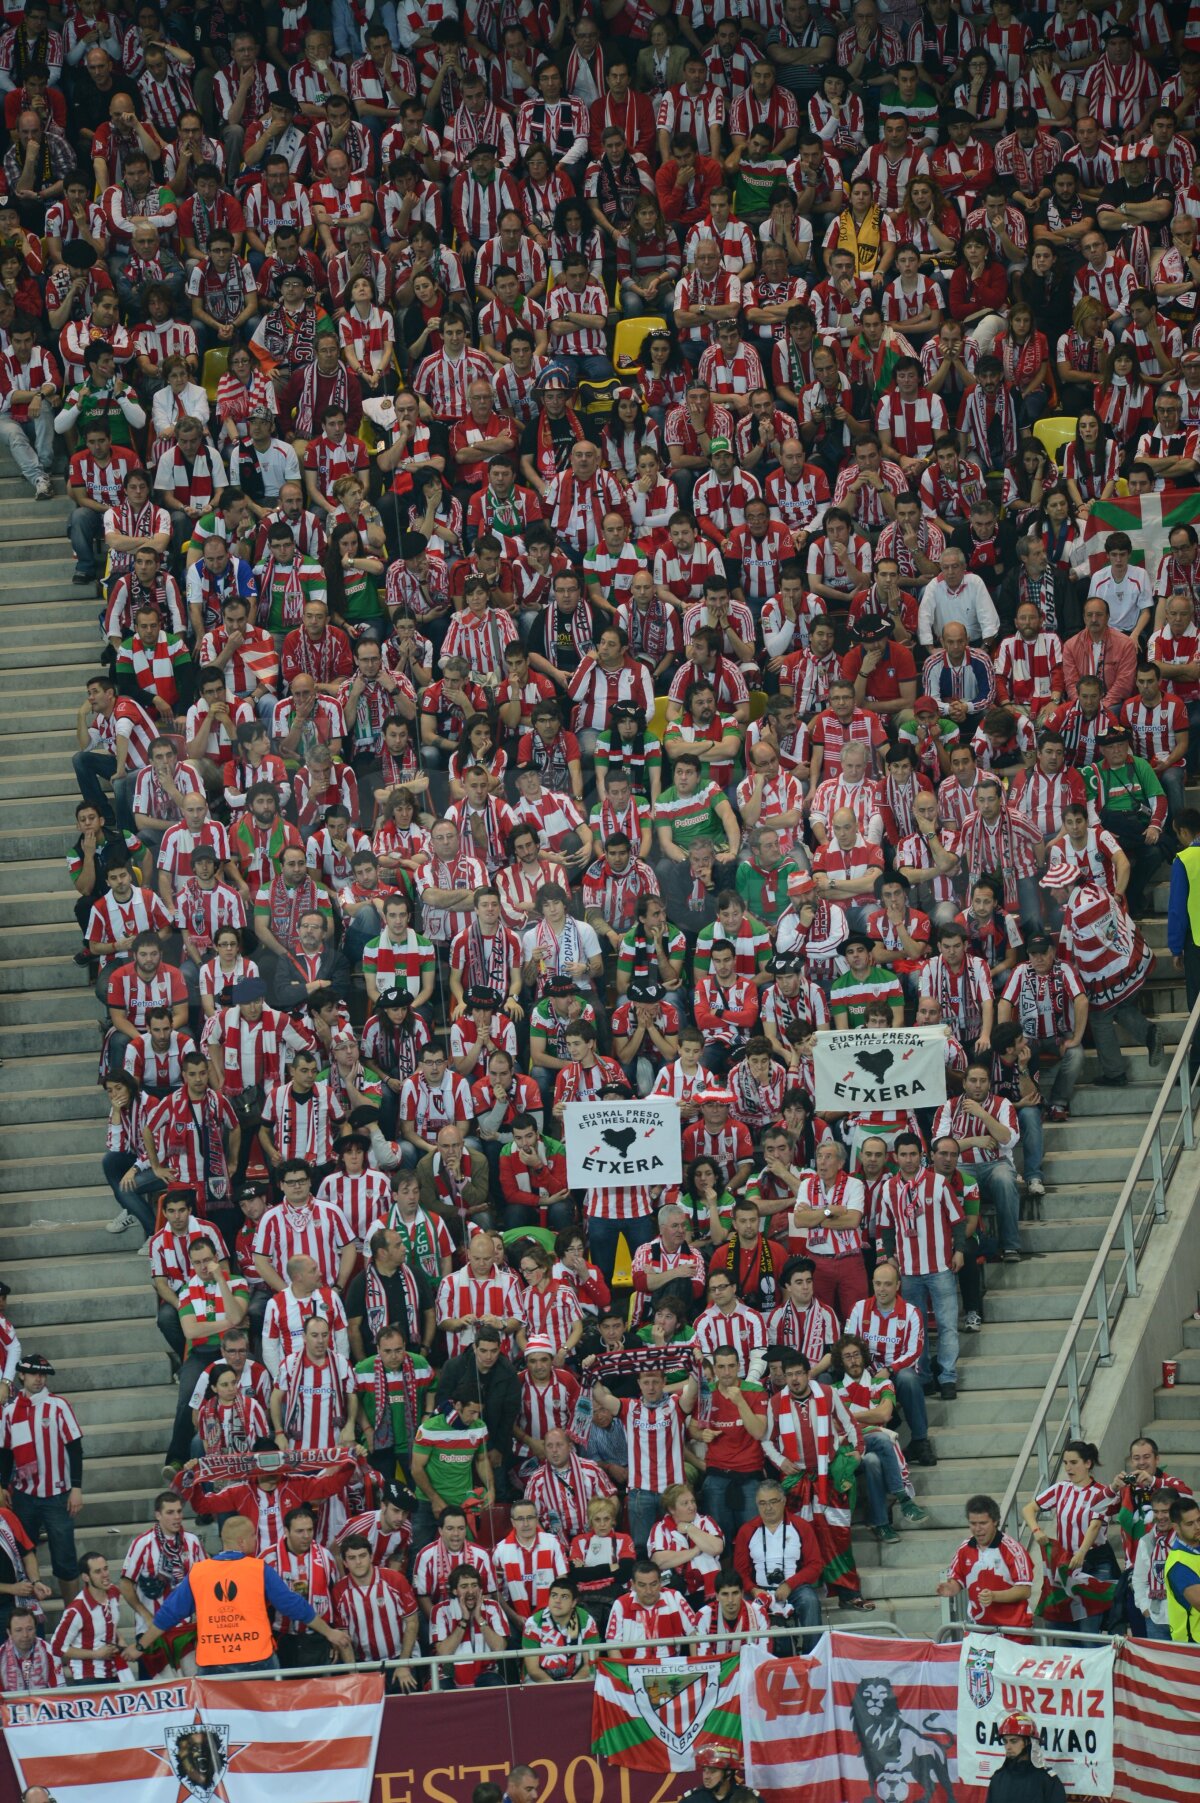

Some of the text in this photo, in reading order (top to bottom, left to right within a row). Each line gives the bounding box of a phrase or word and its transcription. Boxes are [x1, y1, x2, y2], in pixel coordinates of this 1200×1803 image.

[263, 218, 297, 226] Petronor
[87, 482, 122, 492] Petronor
[779, 498, 812, 507] Petronor
[743, 557, 776, 567] Petronor
[1132, 724, 1167, 733] Petronor
[674, 812, 709, 828] Petronor
[832, 1033, 877, 1044] EUSKAL
[828, 1041, 850, 1051] ETA
[834, 1080, 926, 1103] ETXERA
[582, 1110, 660, 1121] EUSKAL PRESO
[579, 1117, 664, 1130] ETA IHESLARIAK
[582, 1155, 664, 1174] ETXERA
[863, 1333, 901, 1344] Petronor
[634, 1419, 671, 1429] Petronor
[289, 1448, 341, 1462] BILBAO
[198, 1456, 247, 1477] ATHLETIC
[227, 1464, 252, 1475] CLUB
[208, 1614, 246, 1623] EUROPA
[200, 1631, 260, 1645] STEWARD
[221, 1644, 242, 1654] 124
[633, 1664, 685, 1674] ATHLETIC
[1015, 1654, 1085, 1680] PEÑA
[8, 1687, 187, 1725] HARRAPARI
[1001, 1683, 1105, 1718] URZAIZ
[659, 1722, 700, 1750] BILBAO
[976, 1721, 1097, 1754] GAAKAO
